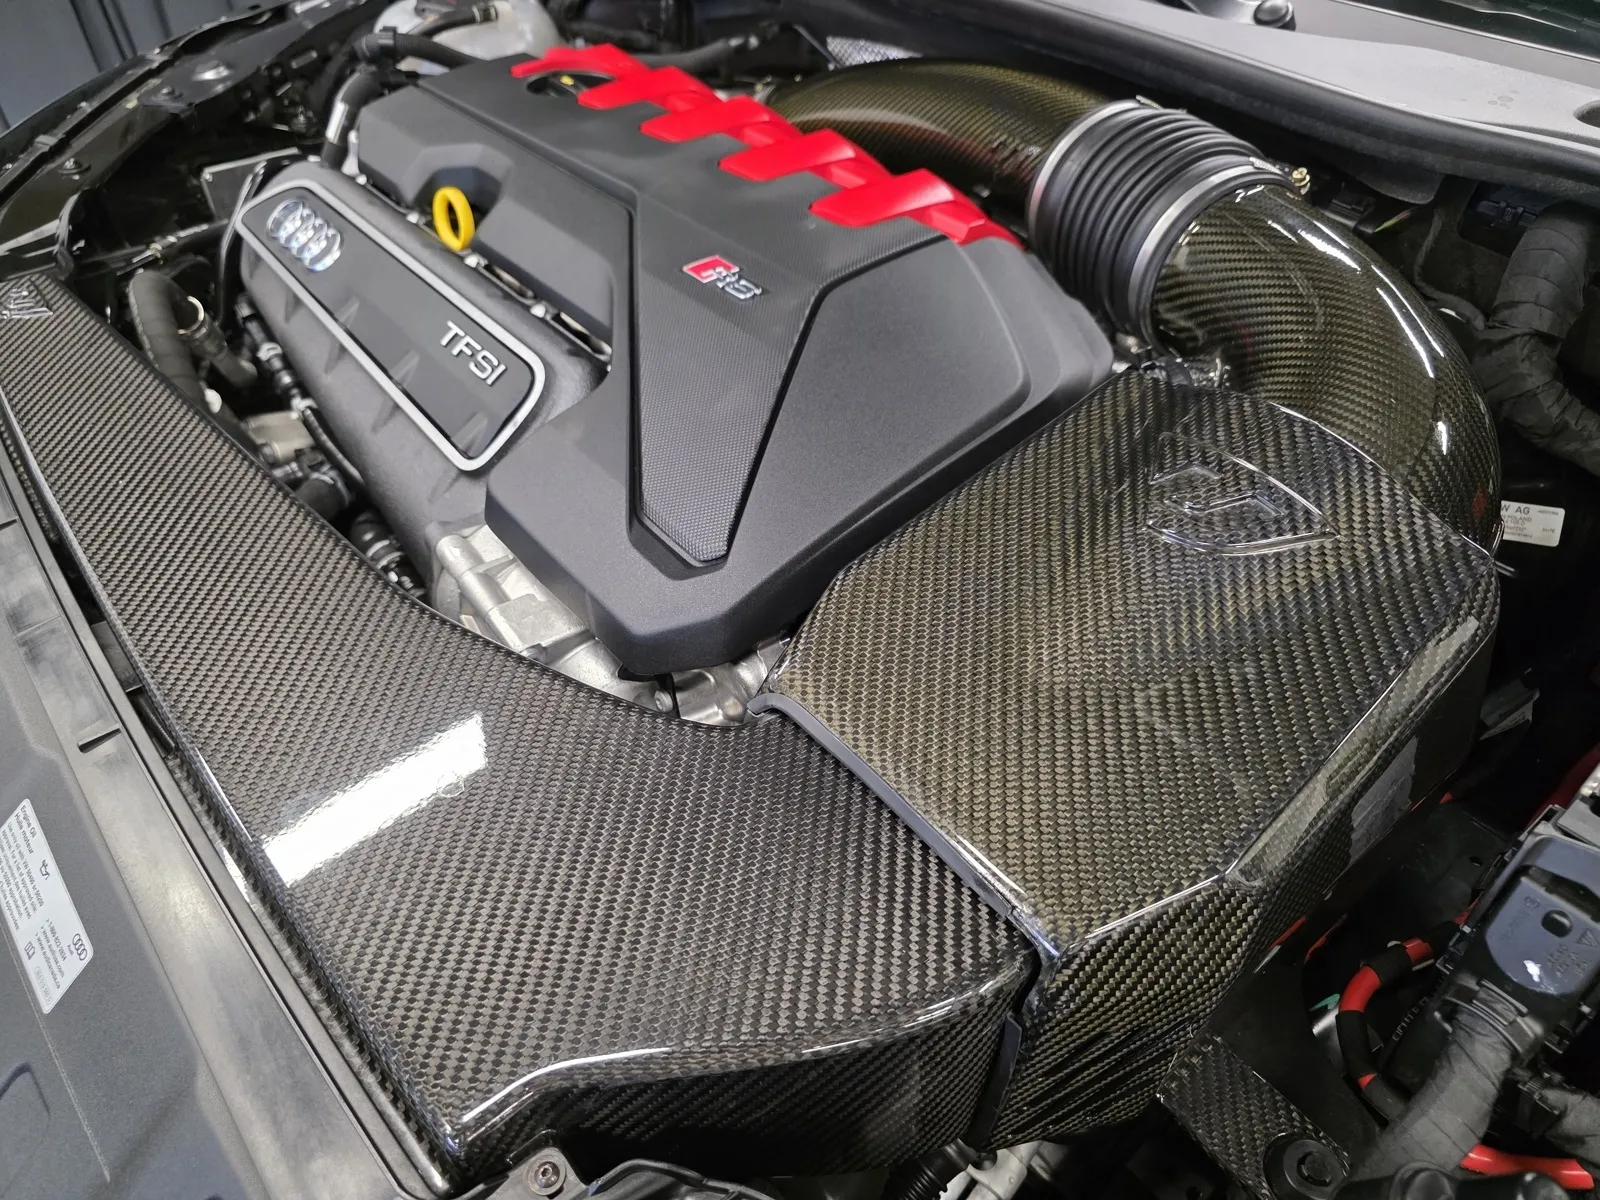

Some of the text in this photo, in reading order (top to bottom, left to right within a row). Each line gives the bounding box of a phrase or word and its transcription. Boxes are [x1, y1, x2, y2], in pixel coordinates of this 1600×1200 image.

[440, 320, 507, 386] TFSI
[1515, 506, 1530, 514] AG
[20, 805, 32, 827] Engine
[14, 812, 33, 854] Huile moteur
